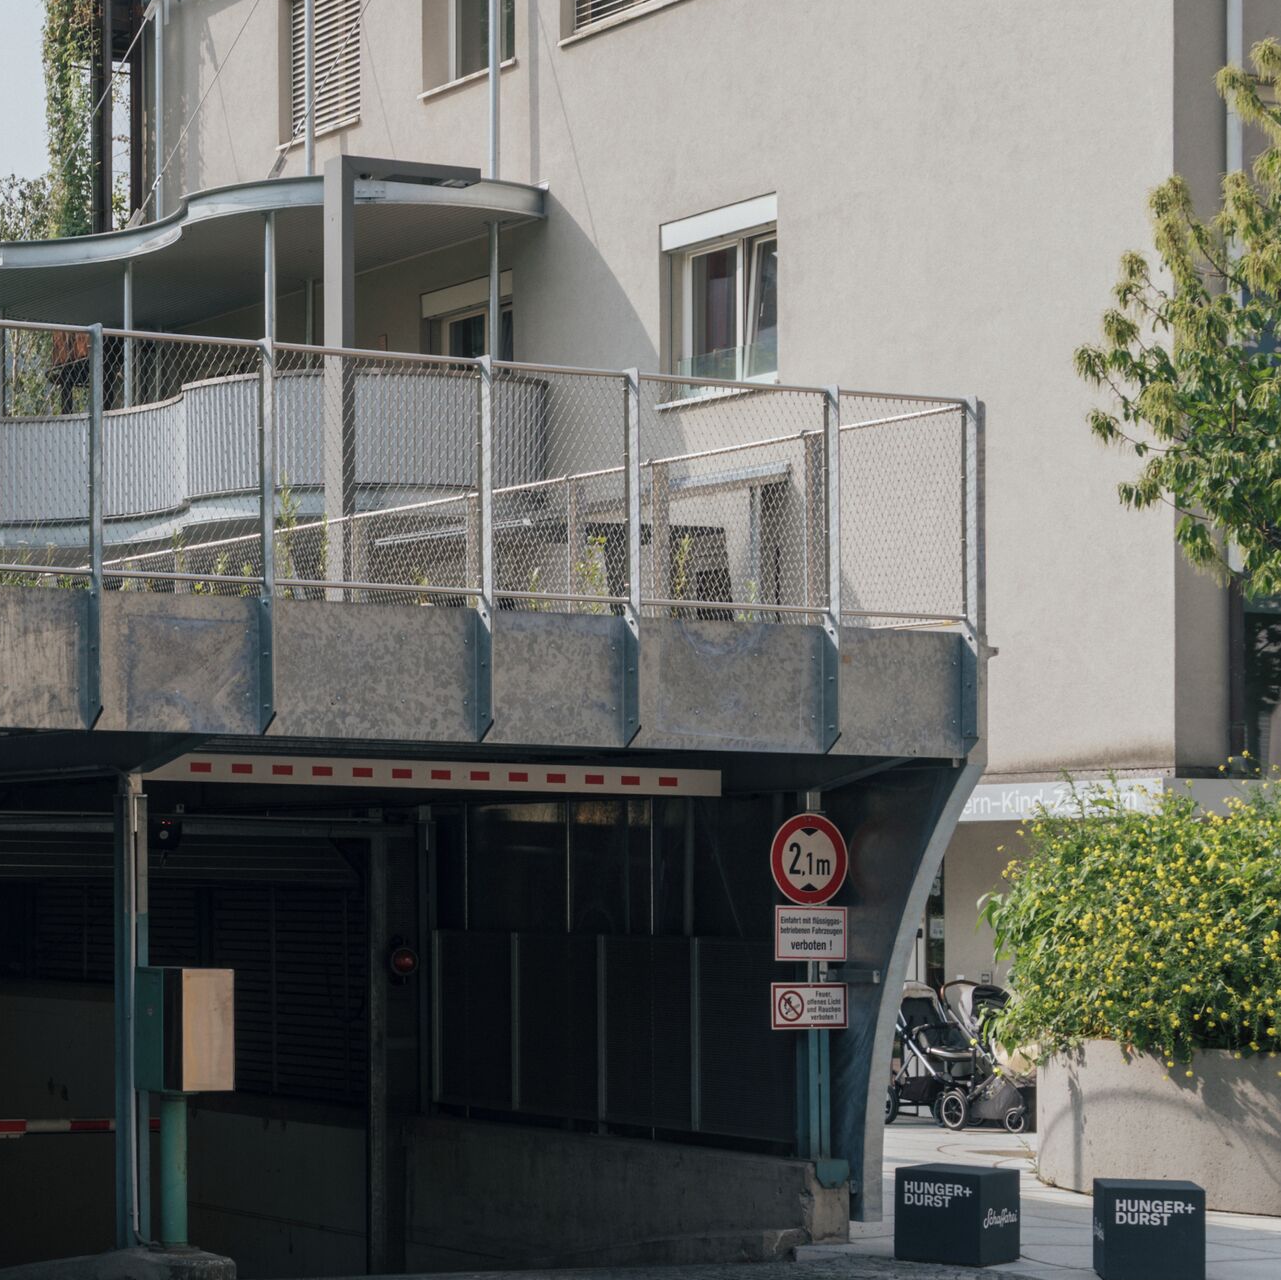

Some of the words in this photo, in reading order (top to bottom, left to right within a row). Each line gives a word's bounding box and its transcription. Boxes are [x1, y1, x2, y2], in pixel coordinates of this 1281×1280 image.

[781, 916, 801, 924] Einfahrt
[812, 927, 842, 936] Fahrzeugen
[791, 939, 826, 950] verboten
[904, 1193, 951, 1208] DURST
[1116, 1212, 1171, 1226] DURST
